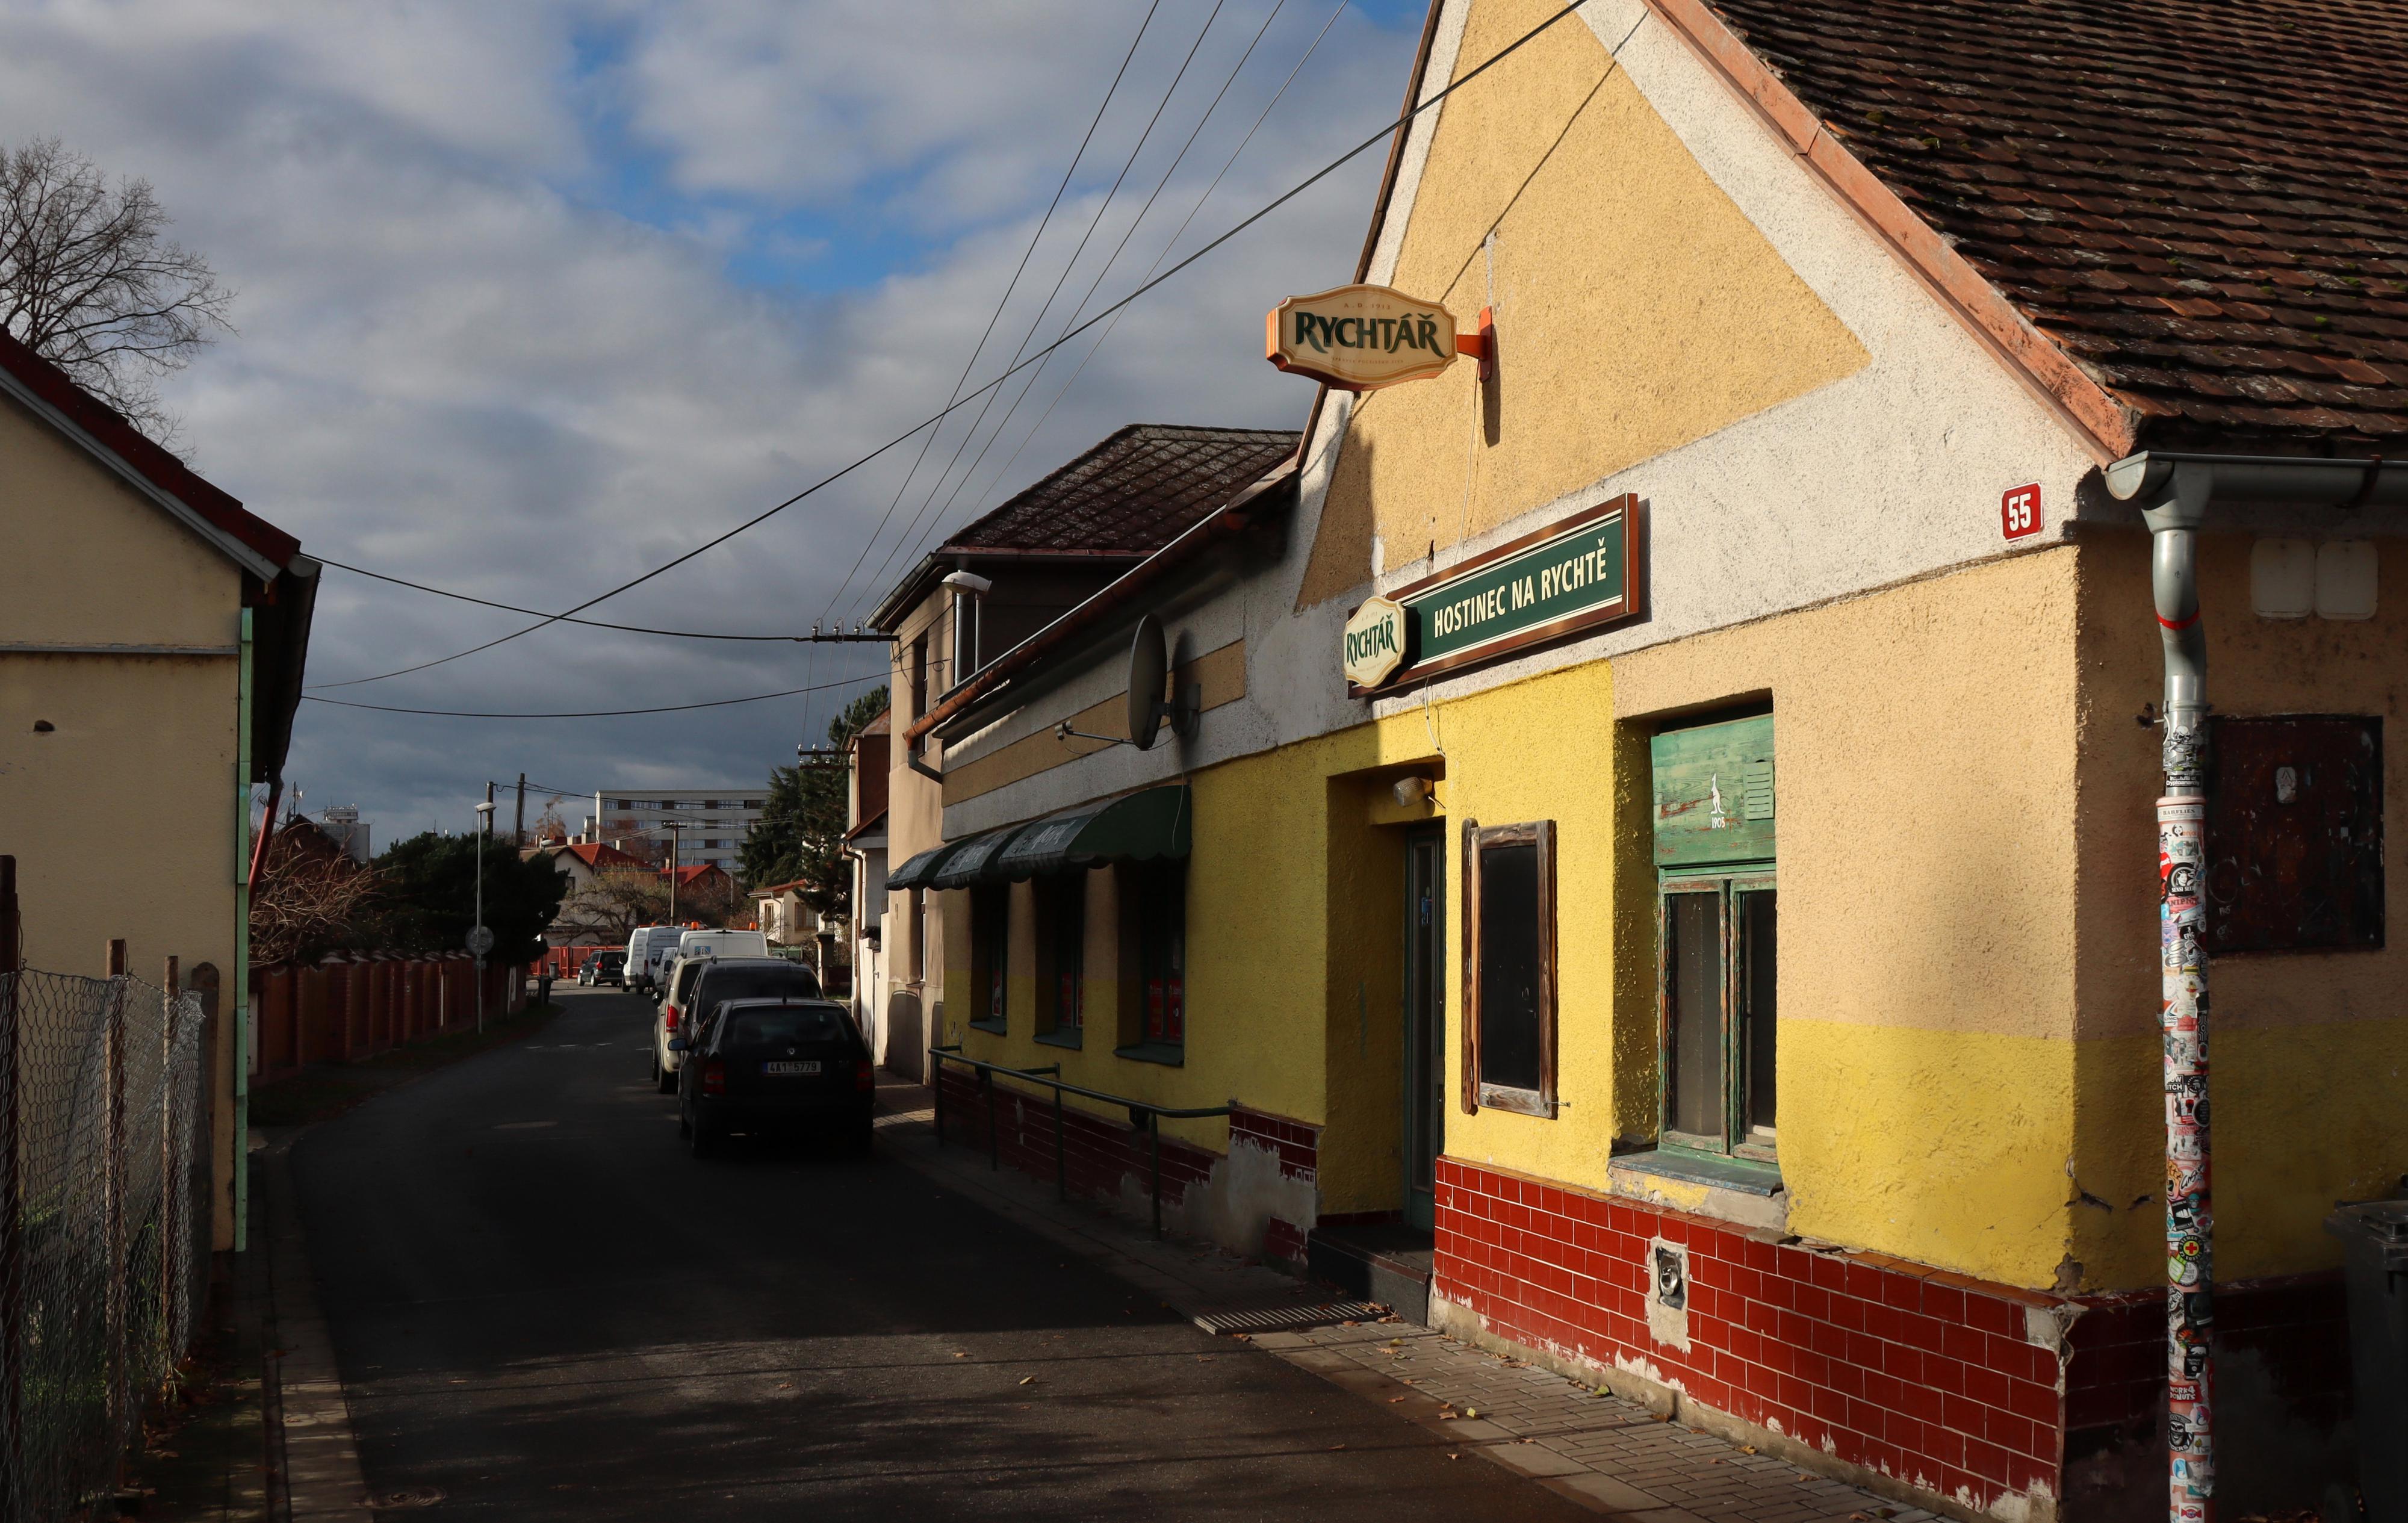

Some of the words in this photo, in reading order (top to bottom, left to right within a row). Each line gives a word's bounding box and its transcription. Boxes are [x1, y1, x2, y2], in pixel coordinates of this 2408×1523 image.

[1295, 311, 1446, 358] RYCHTÁŘ
[2008, 492, 2031, 532] 55
[1435, 585, 1506, 639] HOSTINEC
[1512, 575, 1535, 611] NA
[1541, 536, 1607, 601] RYCHTĚ
[1347, 612, 1398, 668] RYCHTÁŘ
[1711, 816, 1725, 829] 1905
[793, 1062, 817, 1072] 5779
